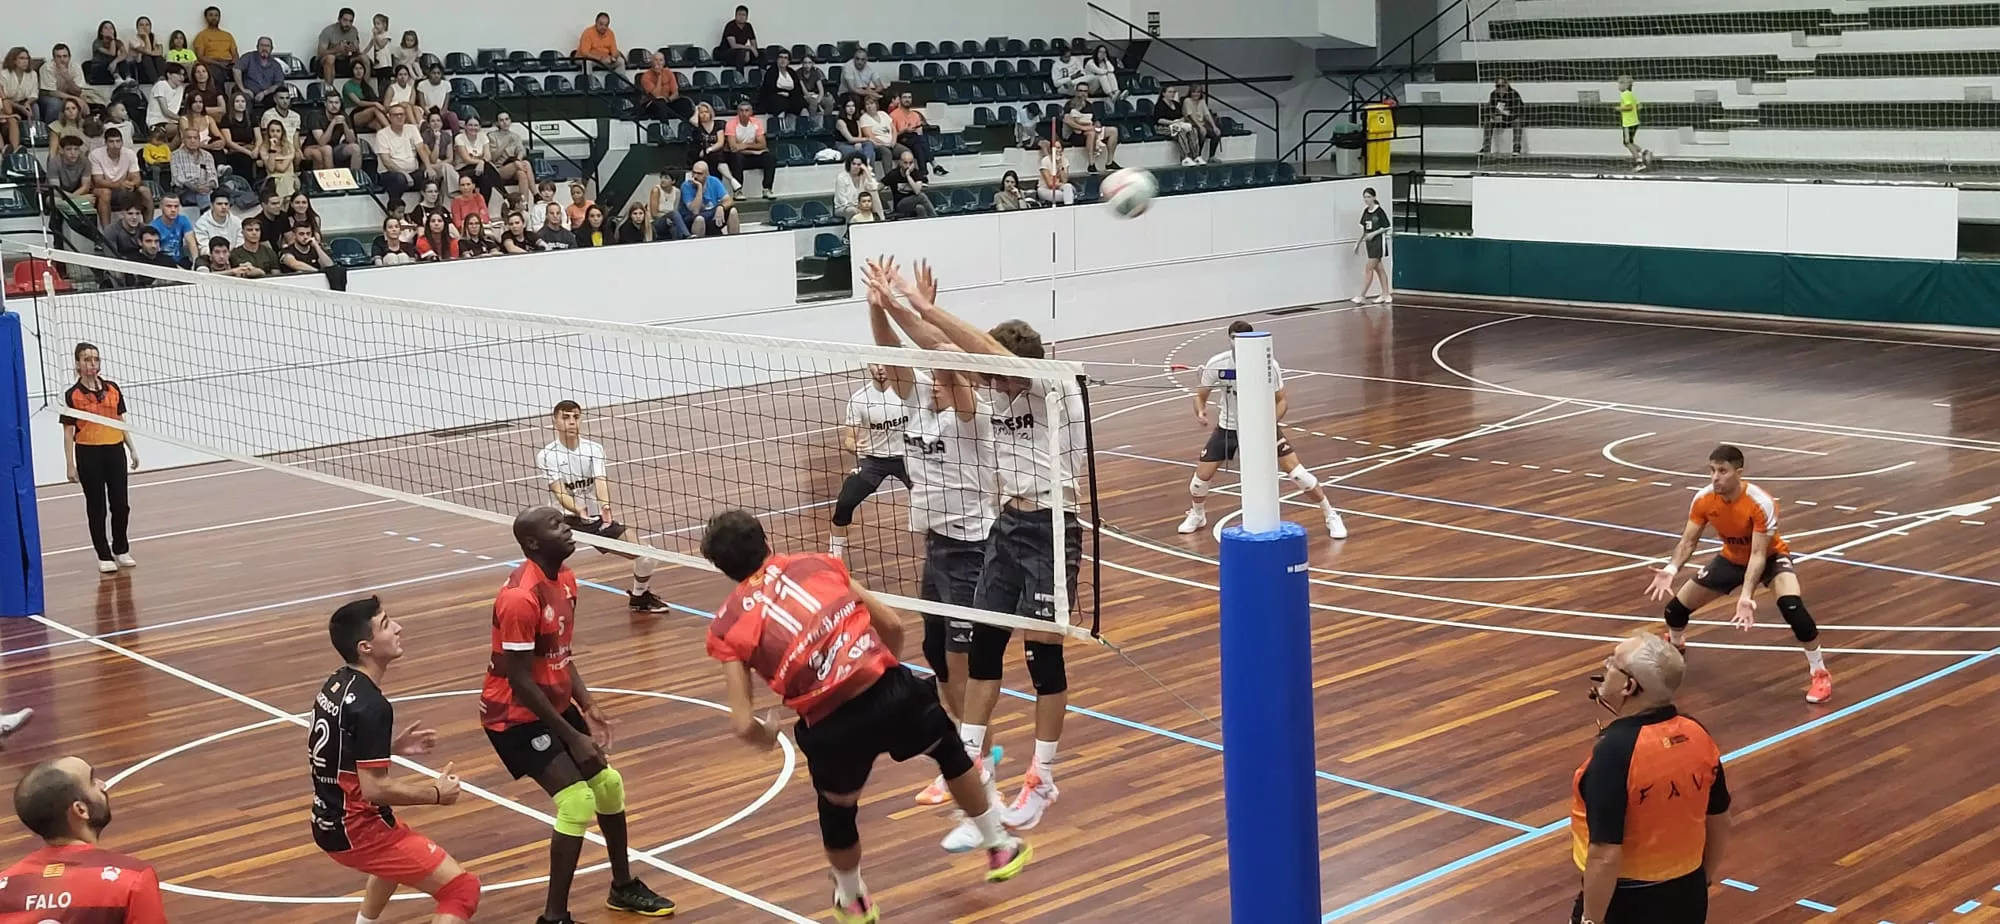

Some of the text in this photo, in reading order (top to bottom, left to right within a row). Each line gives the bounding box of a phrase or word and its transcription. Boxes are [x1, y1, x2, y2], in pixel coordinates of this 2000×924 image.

[761, 573, 822, 637] 11
[558, 615, 565, 636] 5
[25, 891, 72, 911] FALO
